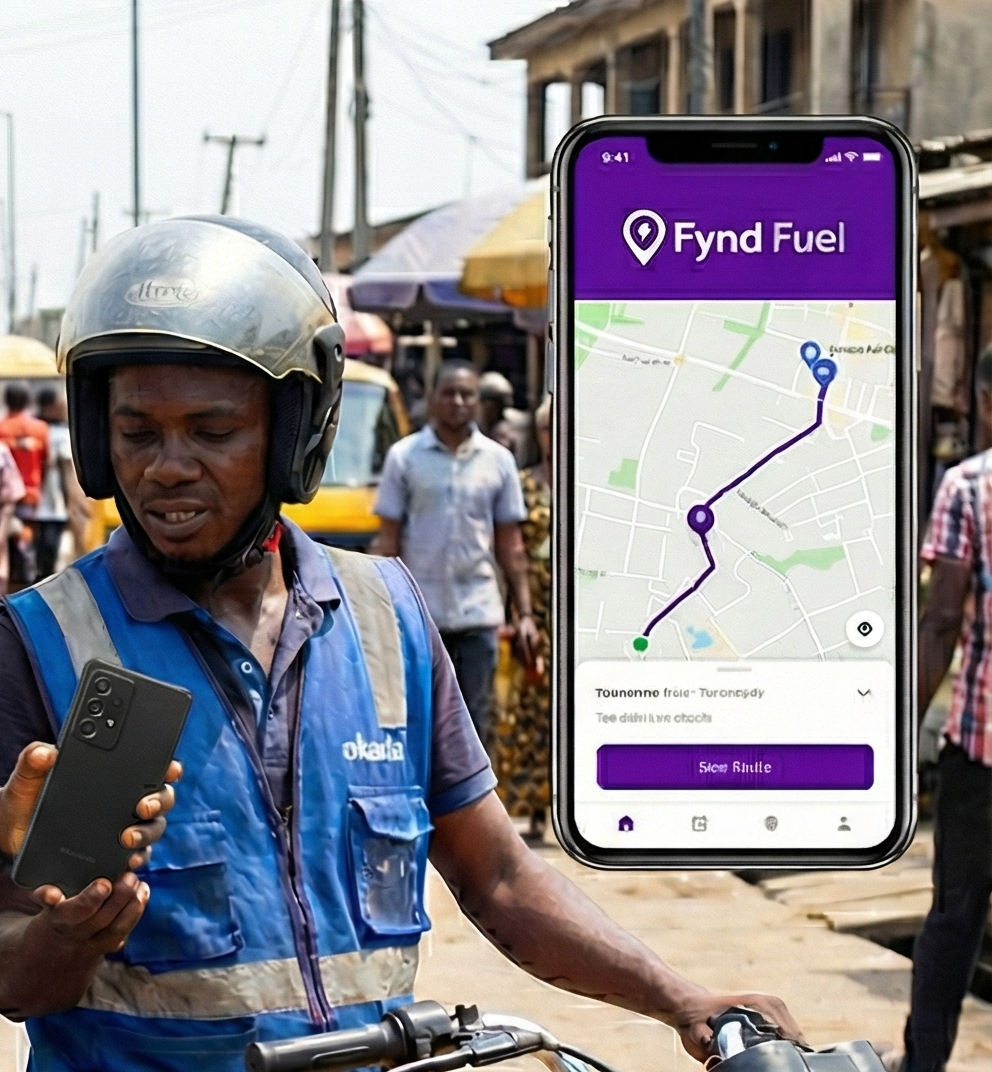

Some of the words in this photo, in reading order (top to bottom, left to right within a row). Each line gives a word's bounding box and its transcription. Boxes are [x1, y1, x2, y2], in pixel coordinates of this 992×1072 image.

[601, 151, 629, 164] 9:41
[674, 221, 762, 262] Fynd
[773, 221, 845, 253] Fuel
